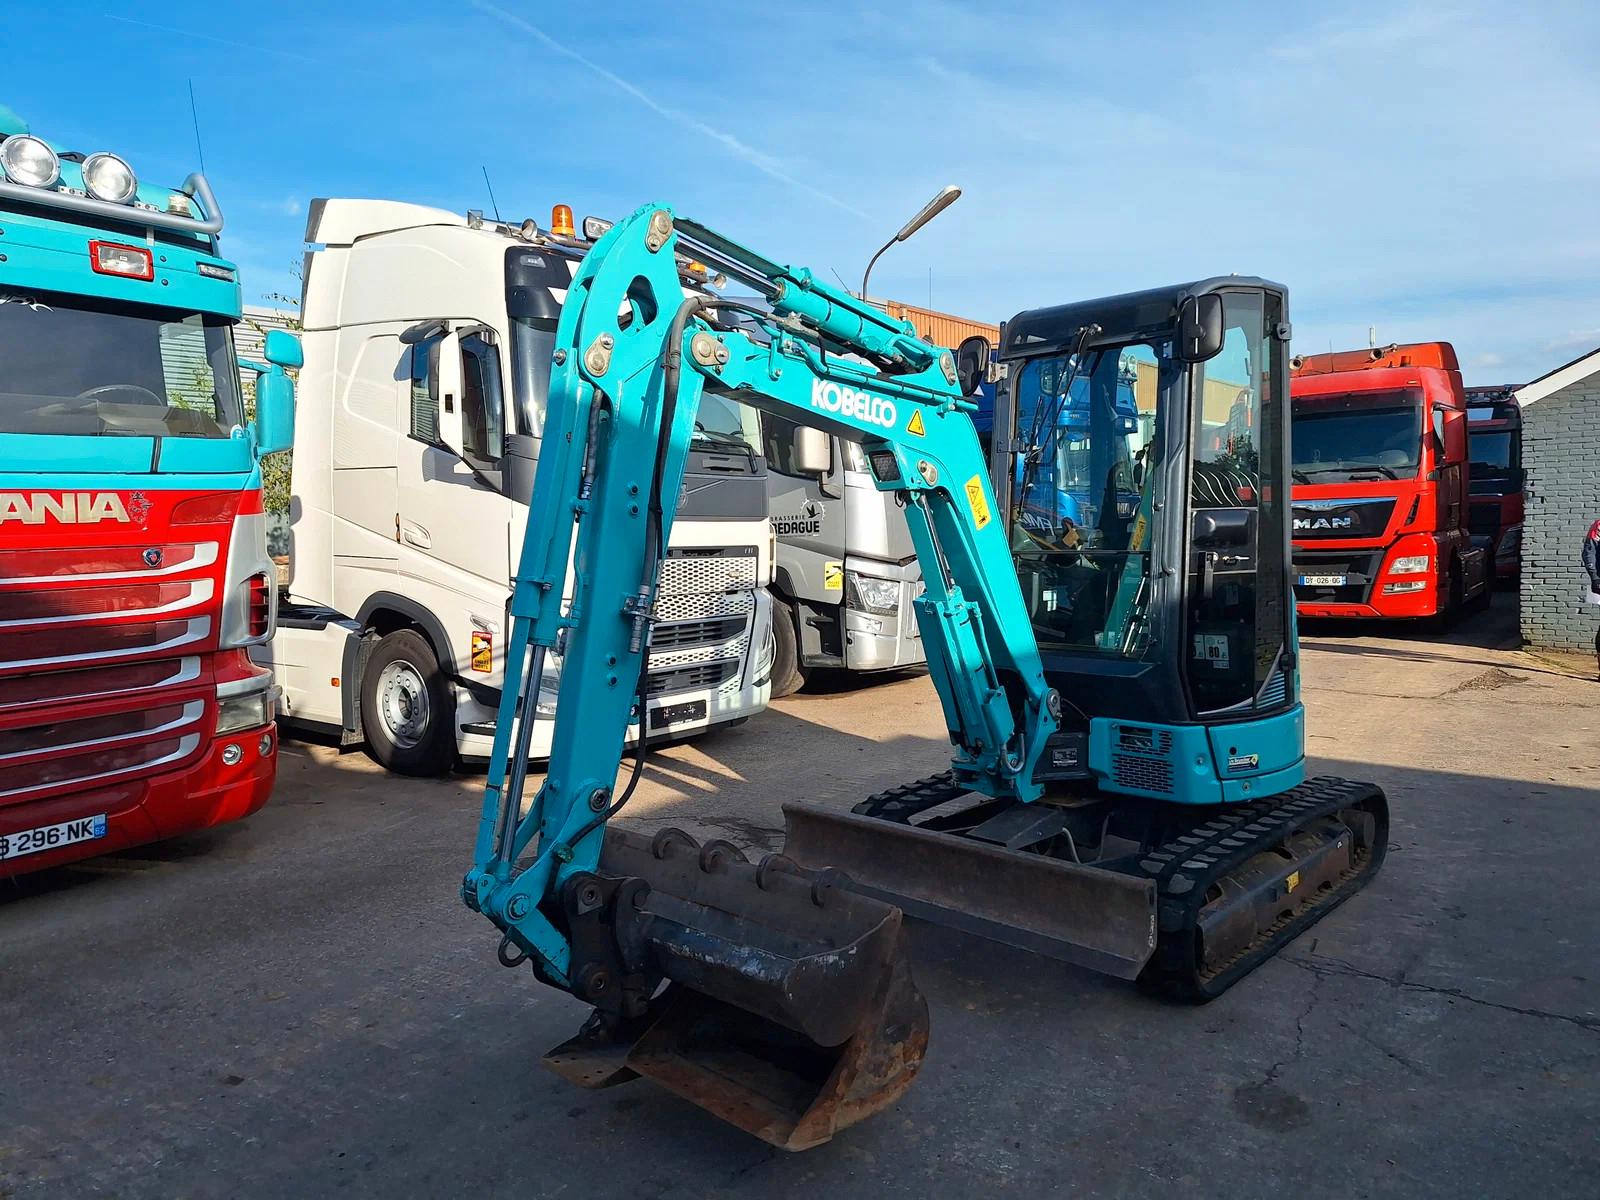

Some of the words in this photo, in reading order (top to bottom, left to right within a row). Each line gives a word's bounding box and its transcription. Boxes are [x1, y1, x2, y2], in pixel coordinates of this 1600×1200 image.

[811, 377, 897, 428] KOBELCO
[0, 493, 131, 524] ANIA
[1293, 517, 1351, 530] MAN
